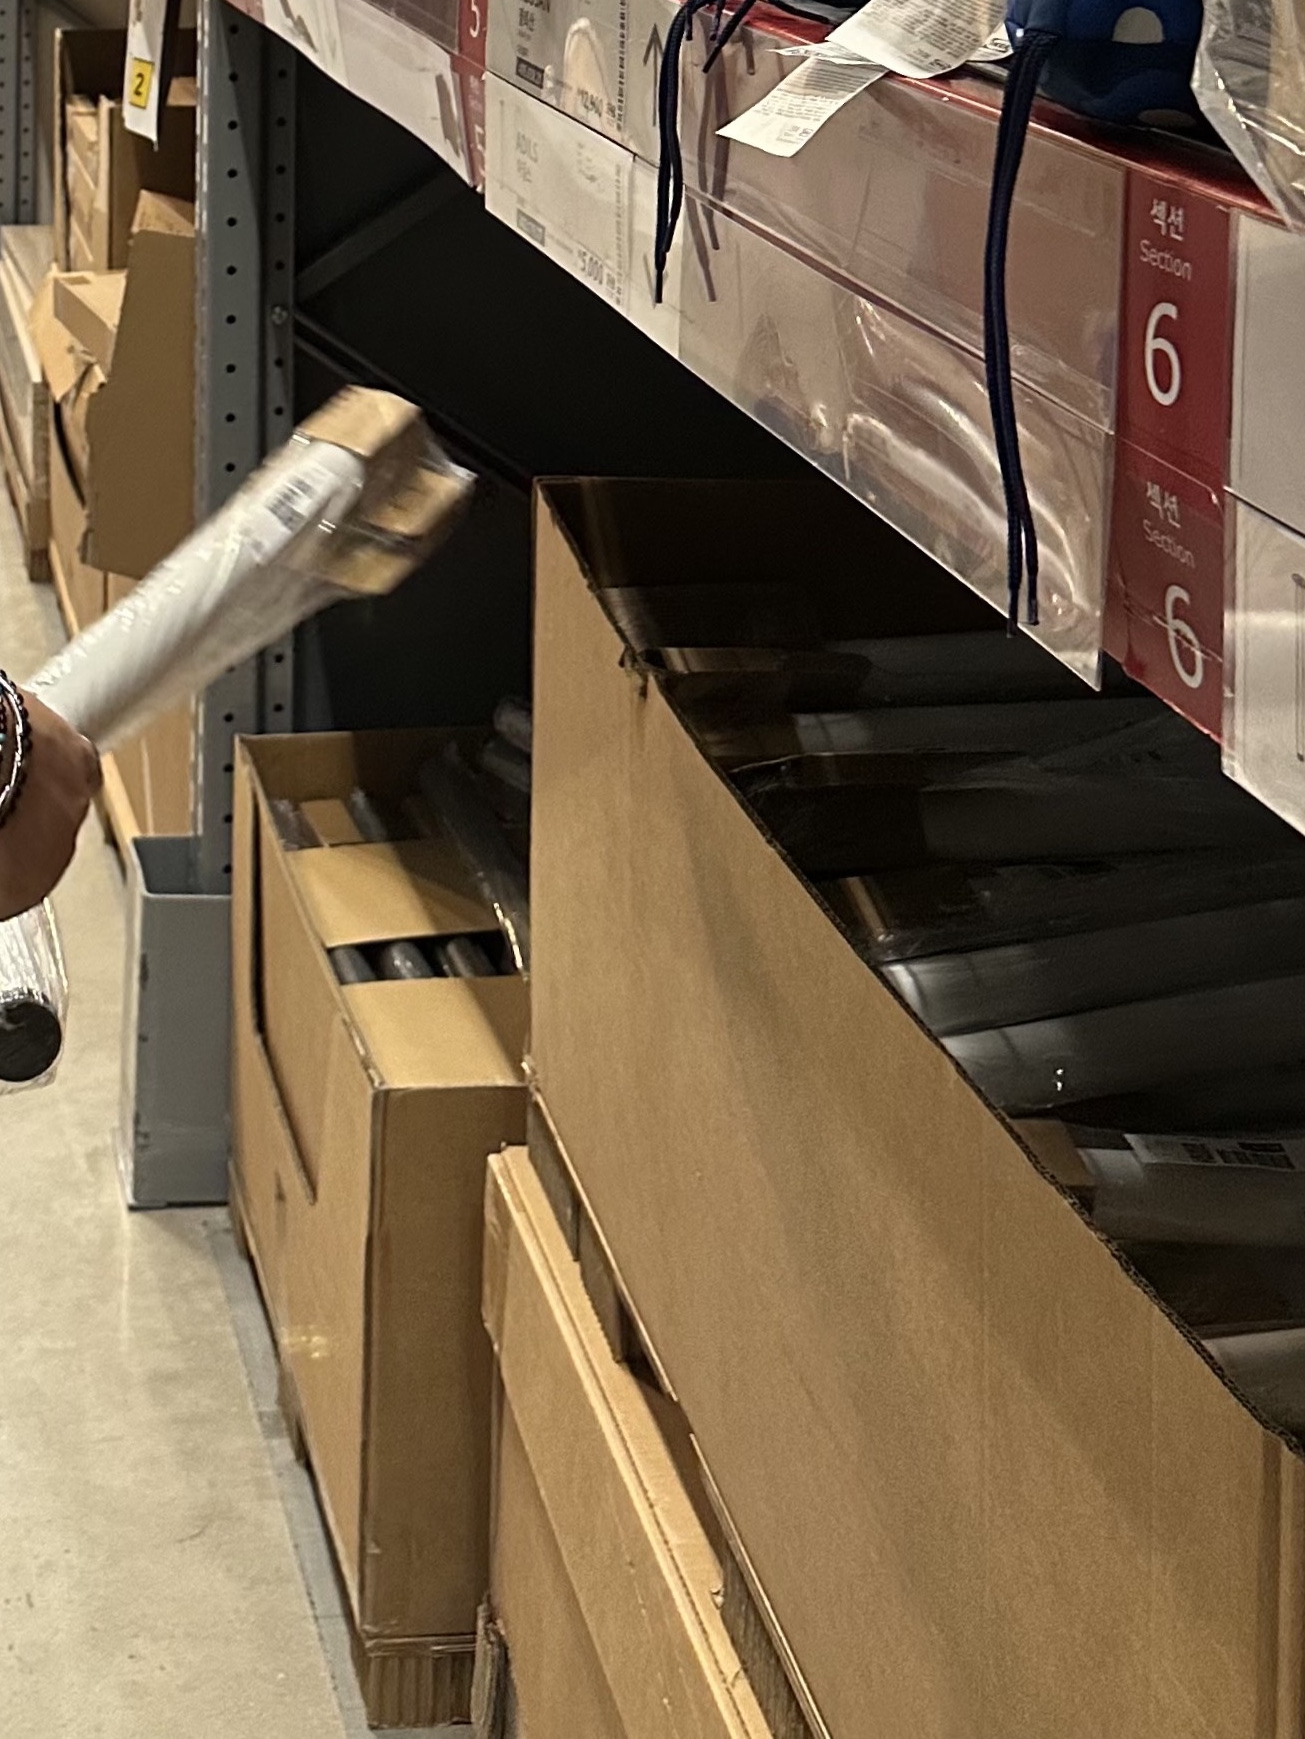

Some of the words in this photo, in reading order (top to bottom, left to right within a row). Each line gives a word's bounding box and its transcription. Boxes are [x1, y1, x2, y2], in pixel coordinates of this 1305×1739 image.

[133, 72, 145, 97] 2
[1150, 198, 1185, 242] 섹션
[1139, 238, 1193, 282] Section
[1144, 301, 1182, 407] 6
[1146, 480, 1182, 529] 섹션
[1142, 518, 1196, 569] Section
[1164, 584, 1204, 689] 6
